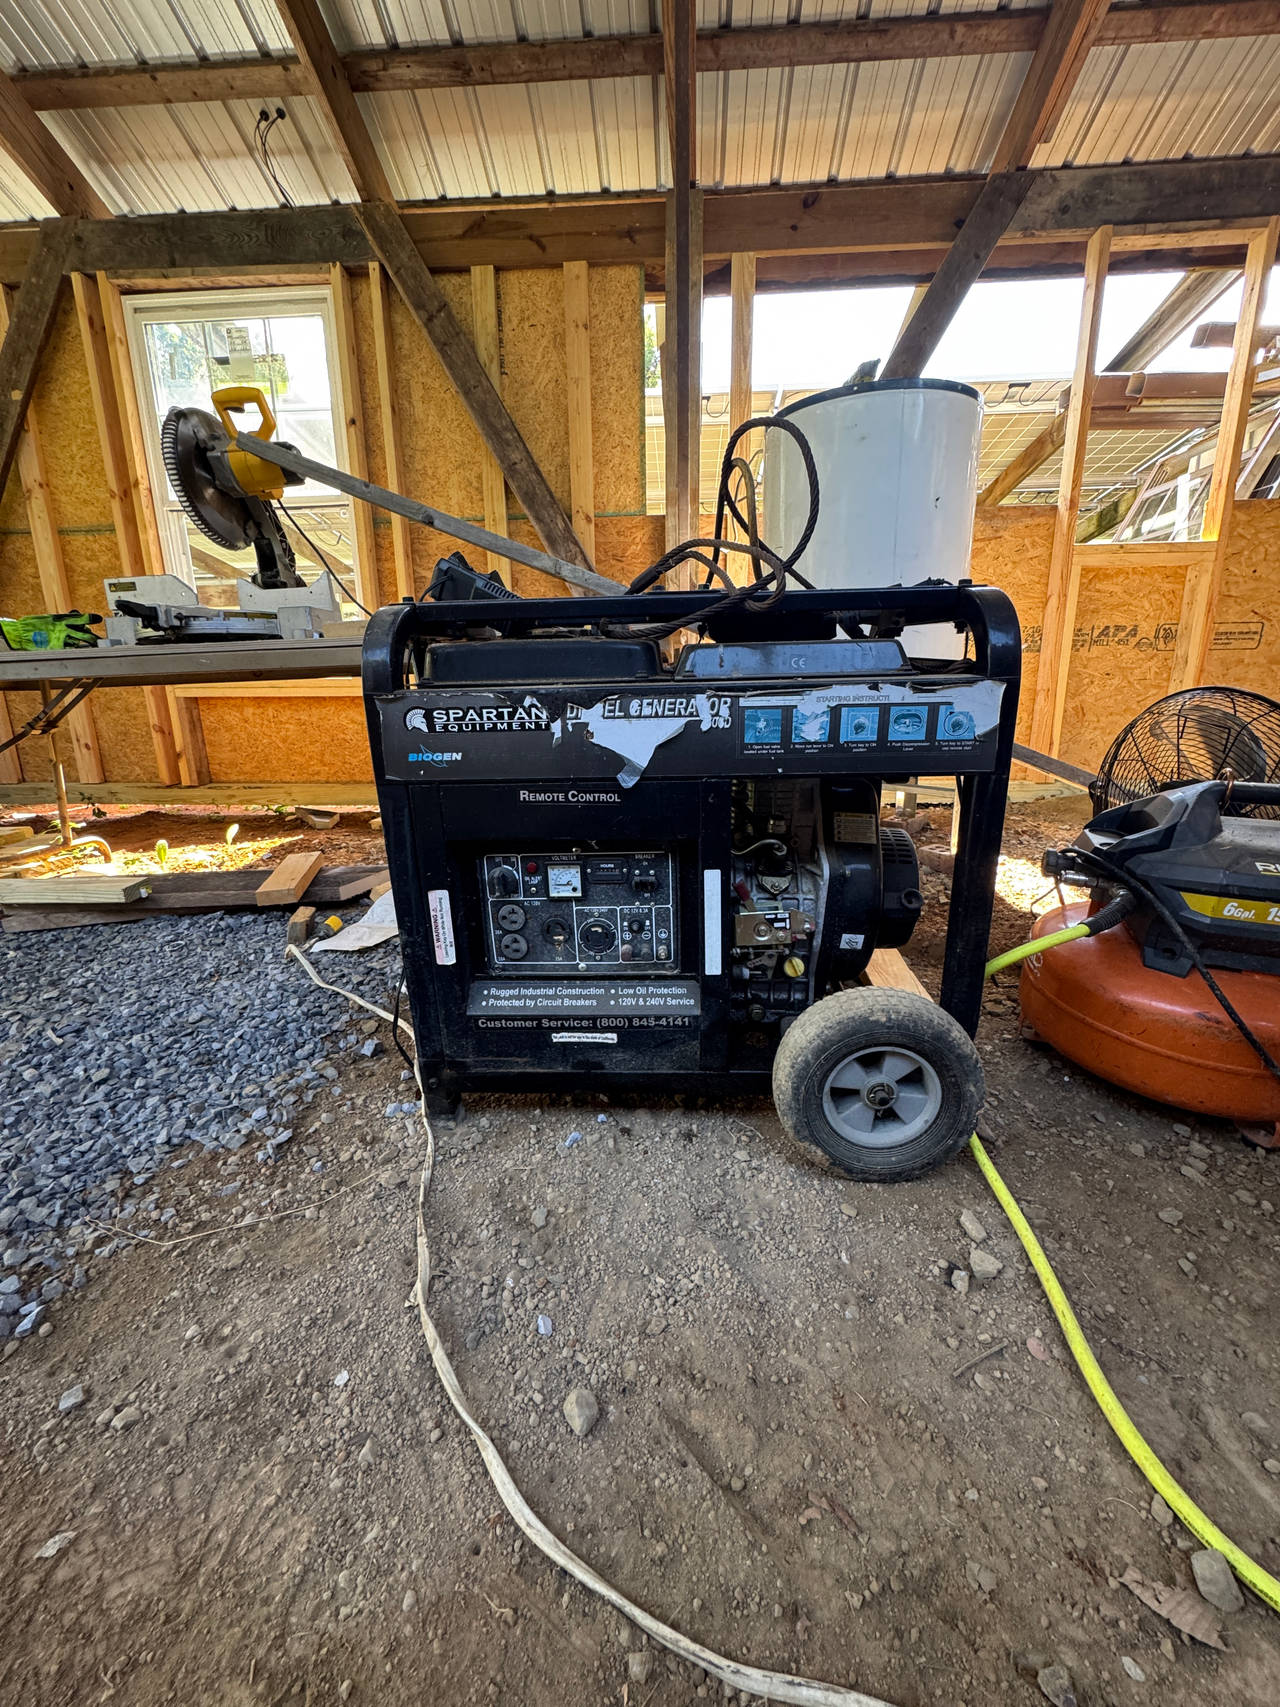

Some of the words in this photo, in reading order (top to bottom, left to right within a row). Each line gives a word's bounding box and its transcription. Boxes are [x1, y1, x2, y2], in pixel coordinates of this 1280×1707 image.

[1096, 625, 1139, 638] APA
[567, 699, 624, 718] DIEL
[631, 697, 731, 717] GENERAOR
[432, 707, 548, 721] SPARTAN
[435, 721, 548, 732] EQUIPMENT
[407, 752, 462, 762] BIOGEN
[432, 914, 441, 943] WARNING
[490, 987, 519, 997] Rugged
[520, 987, 555, 996] Industrial
[556, 986, 605, 995] Construction
[618, 987, 634, 995] Low
[635, 986, 647, 995] Oil
[648, 986, 687, 995] Protection
[488, 998, 524, 1006] Protected
[526, 998, 535, 1008] by
[537, 998, 561, 1006] Circuit
[563, 998, 598, 1006] Breakers
[618, 998, 637, 1006] 120V
[646, 997, 665, 1006] 240V
[666, 997, 695, 1006] Service
[478, 1018, 538, 1028] Customer
[541, 1018, 593, 1028] Service:
[596, 1017, 629, 1029] (800)
[632, 1017, 689, 1027] 845-4141
